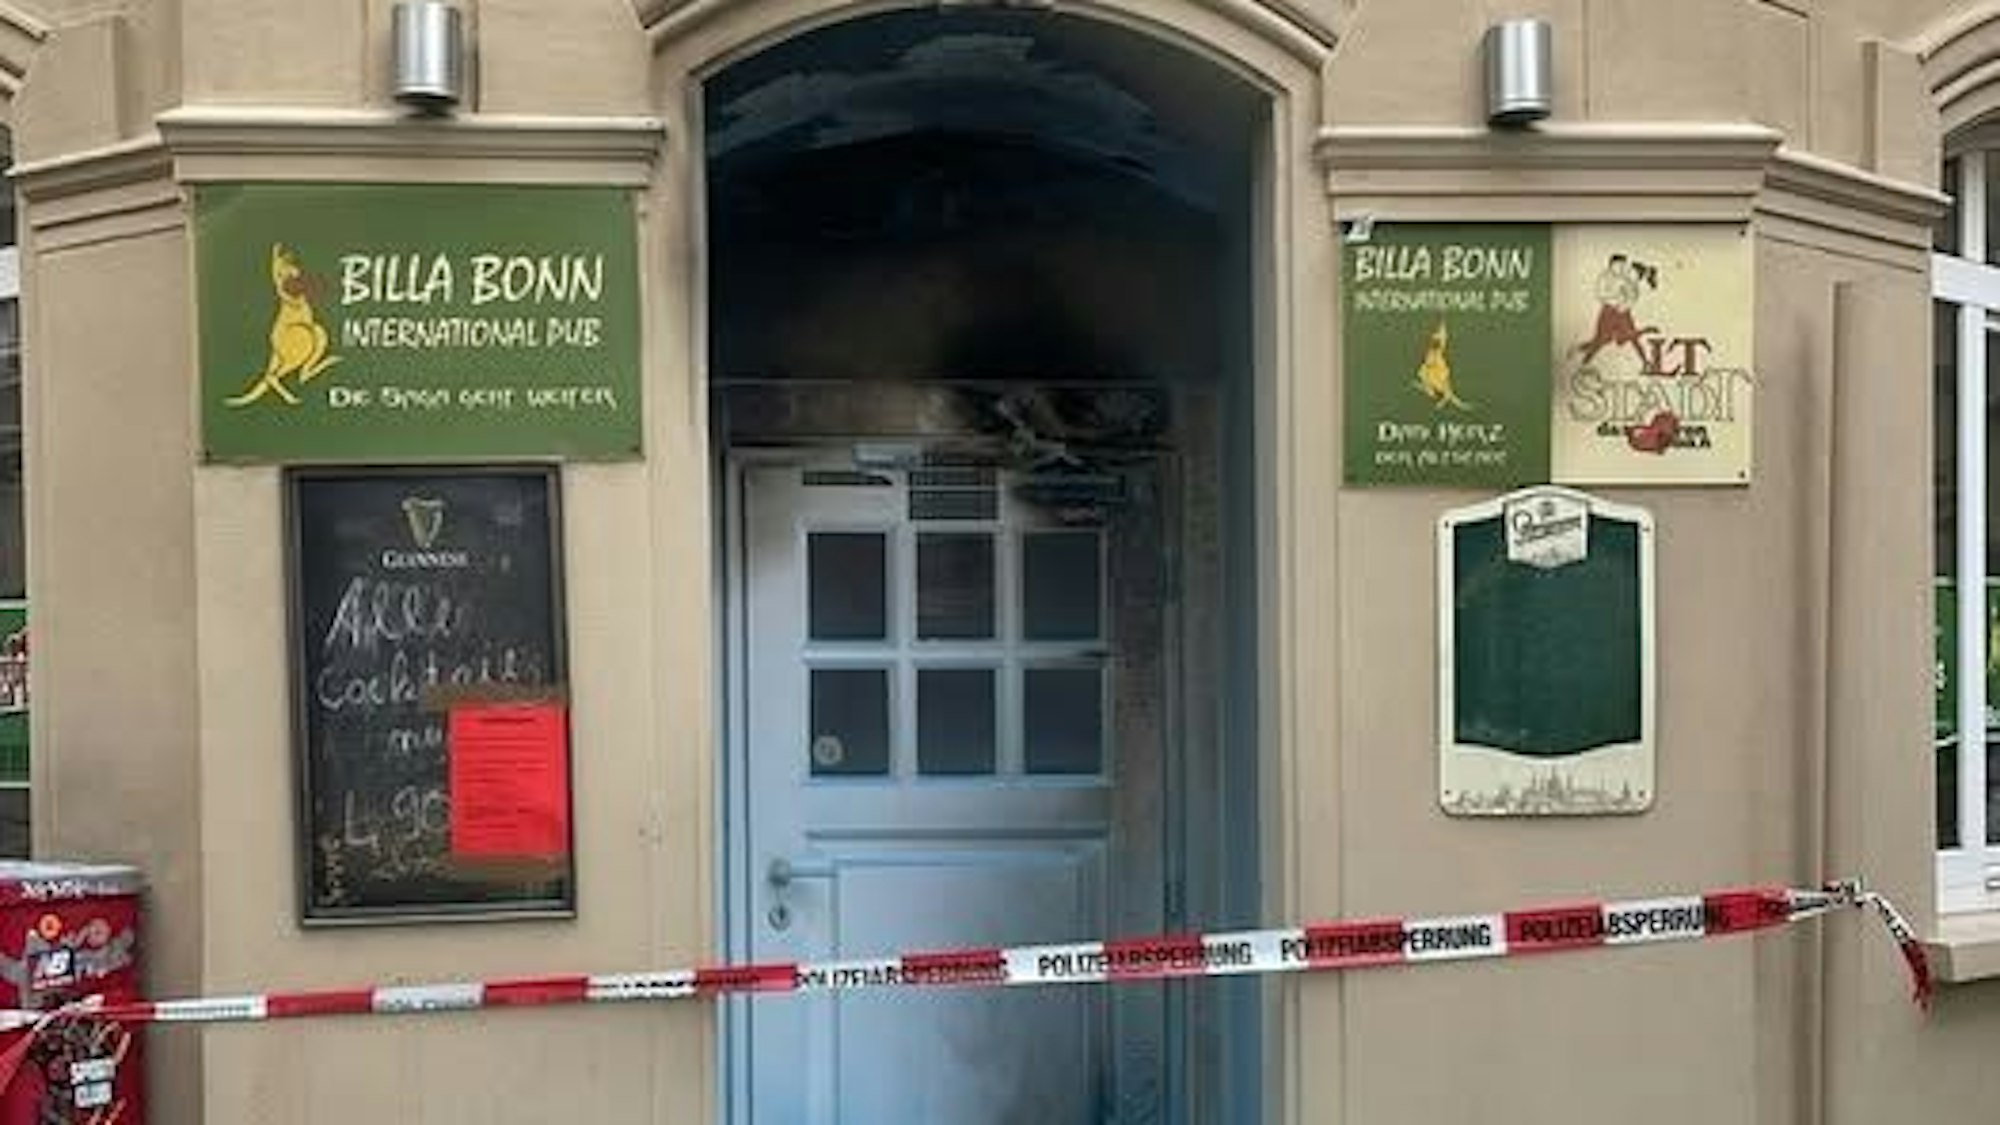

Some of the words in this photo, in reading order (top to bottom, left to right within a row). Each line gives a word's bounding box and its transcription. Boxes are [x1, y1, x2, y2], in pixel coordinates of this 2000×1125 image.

[339, 251, 454, 305] BILLA
[470, 250, 604, 305] BONN
[1355, 245, 1432, 282] BILLA
[1441, 245, 1535, 282] BONN
[342, 316, 538, 350] INTERNATIONAL
[546, 317, 600, 349] PUB
[1519, 899, 1731, 943] POLIZEIABSPERRUNG
[1037, 942, 1252, 978] POLIZEIABSPERRUNG
[1280, 923, 1491, 962] POLIZEIABSPERRUNG
